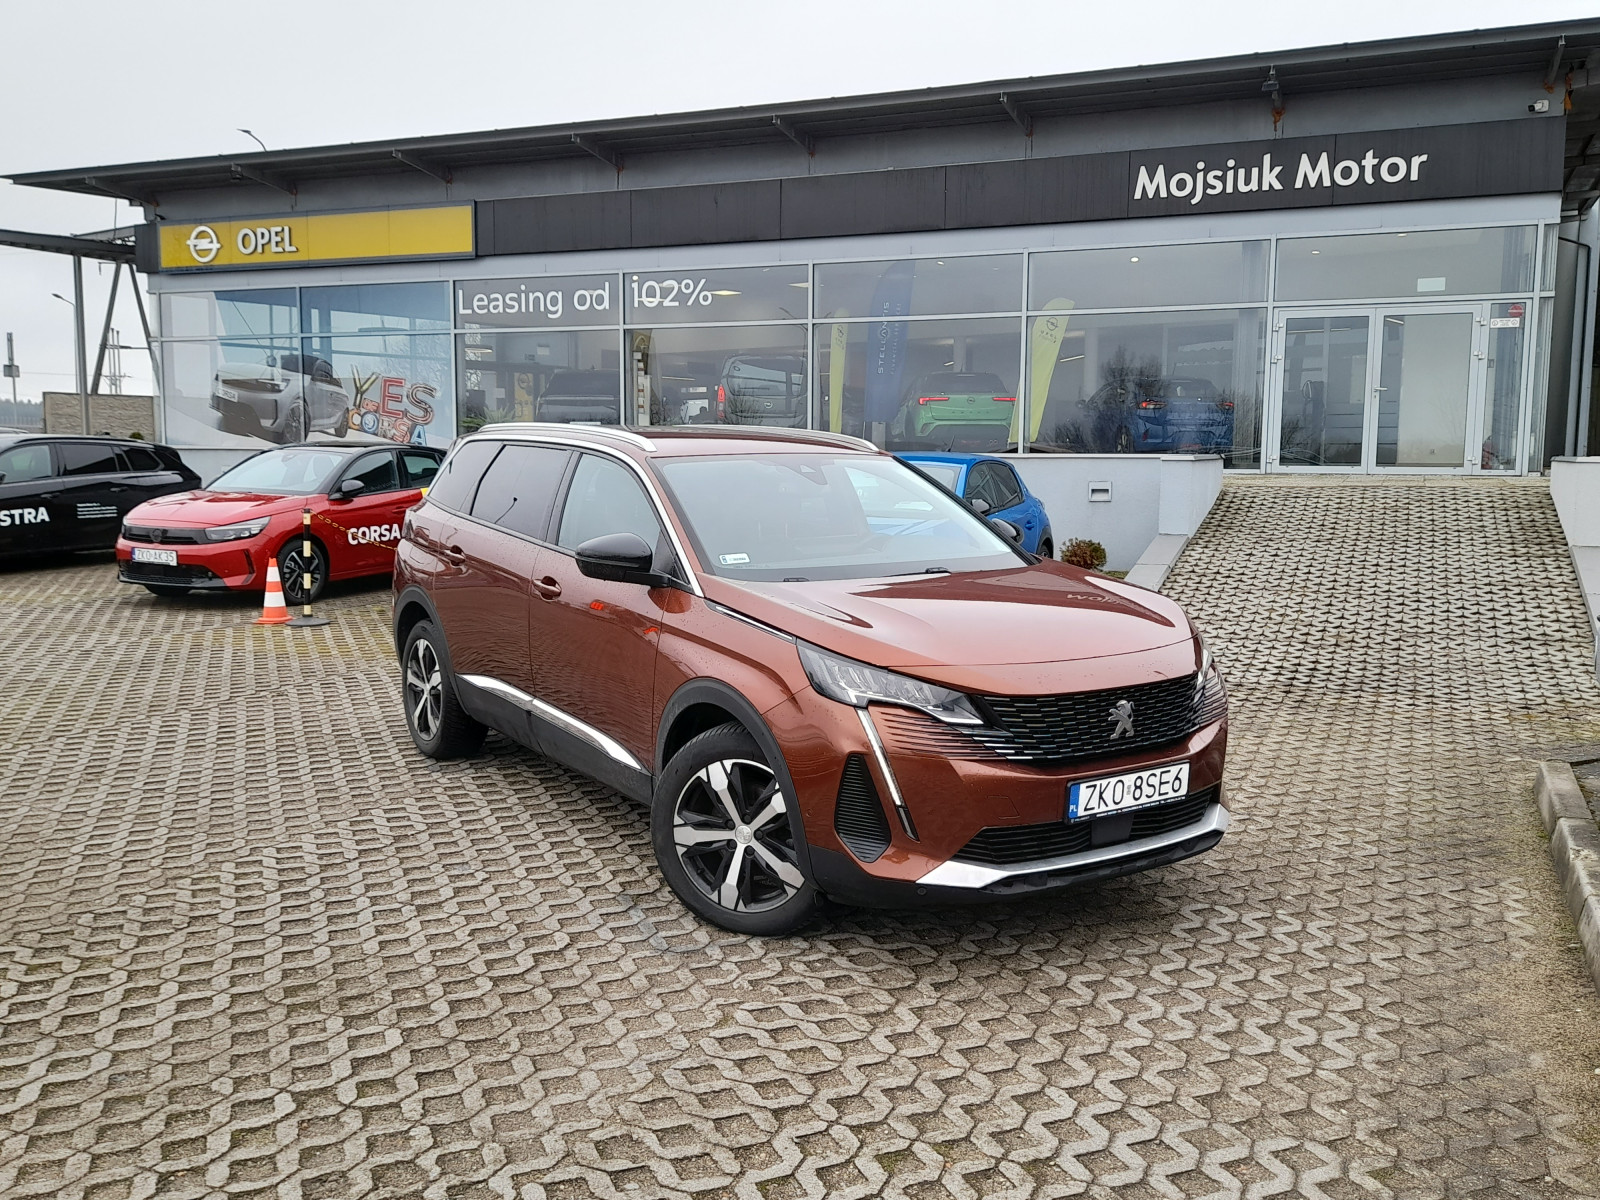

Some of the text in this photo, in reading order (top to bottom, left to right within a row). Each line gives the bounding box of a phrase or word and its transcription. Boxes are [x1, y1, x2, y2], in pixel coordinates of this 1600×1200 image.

[1133, 149, 1428, 205] Mojsiuk Motor
[237, 226, 298, 255] OPEL
[458, 284, 563, 319] Leasing
[573, 281, 610, 311] od
[350, 364, 436, 425] YES
[348, 407, 427, 446] CORSA
[0, 506, 50, 527] STRA
[348, 523, 401, 545] CORSA
[1132, 767, 1183, 801] 8SE6
[1069, 804, 1078, 812] PL
